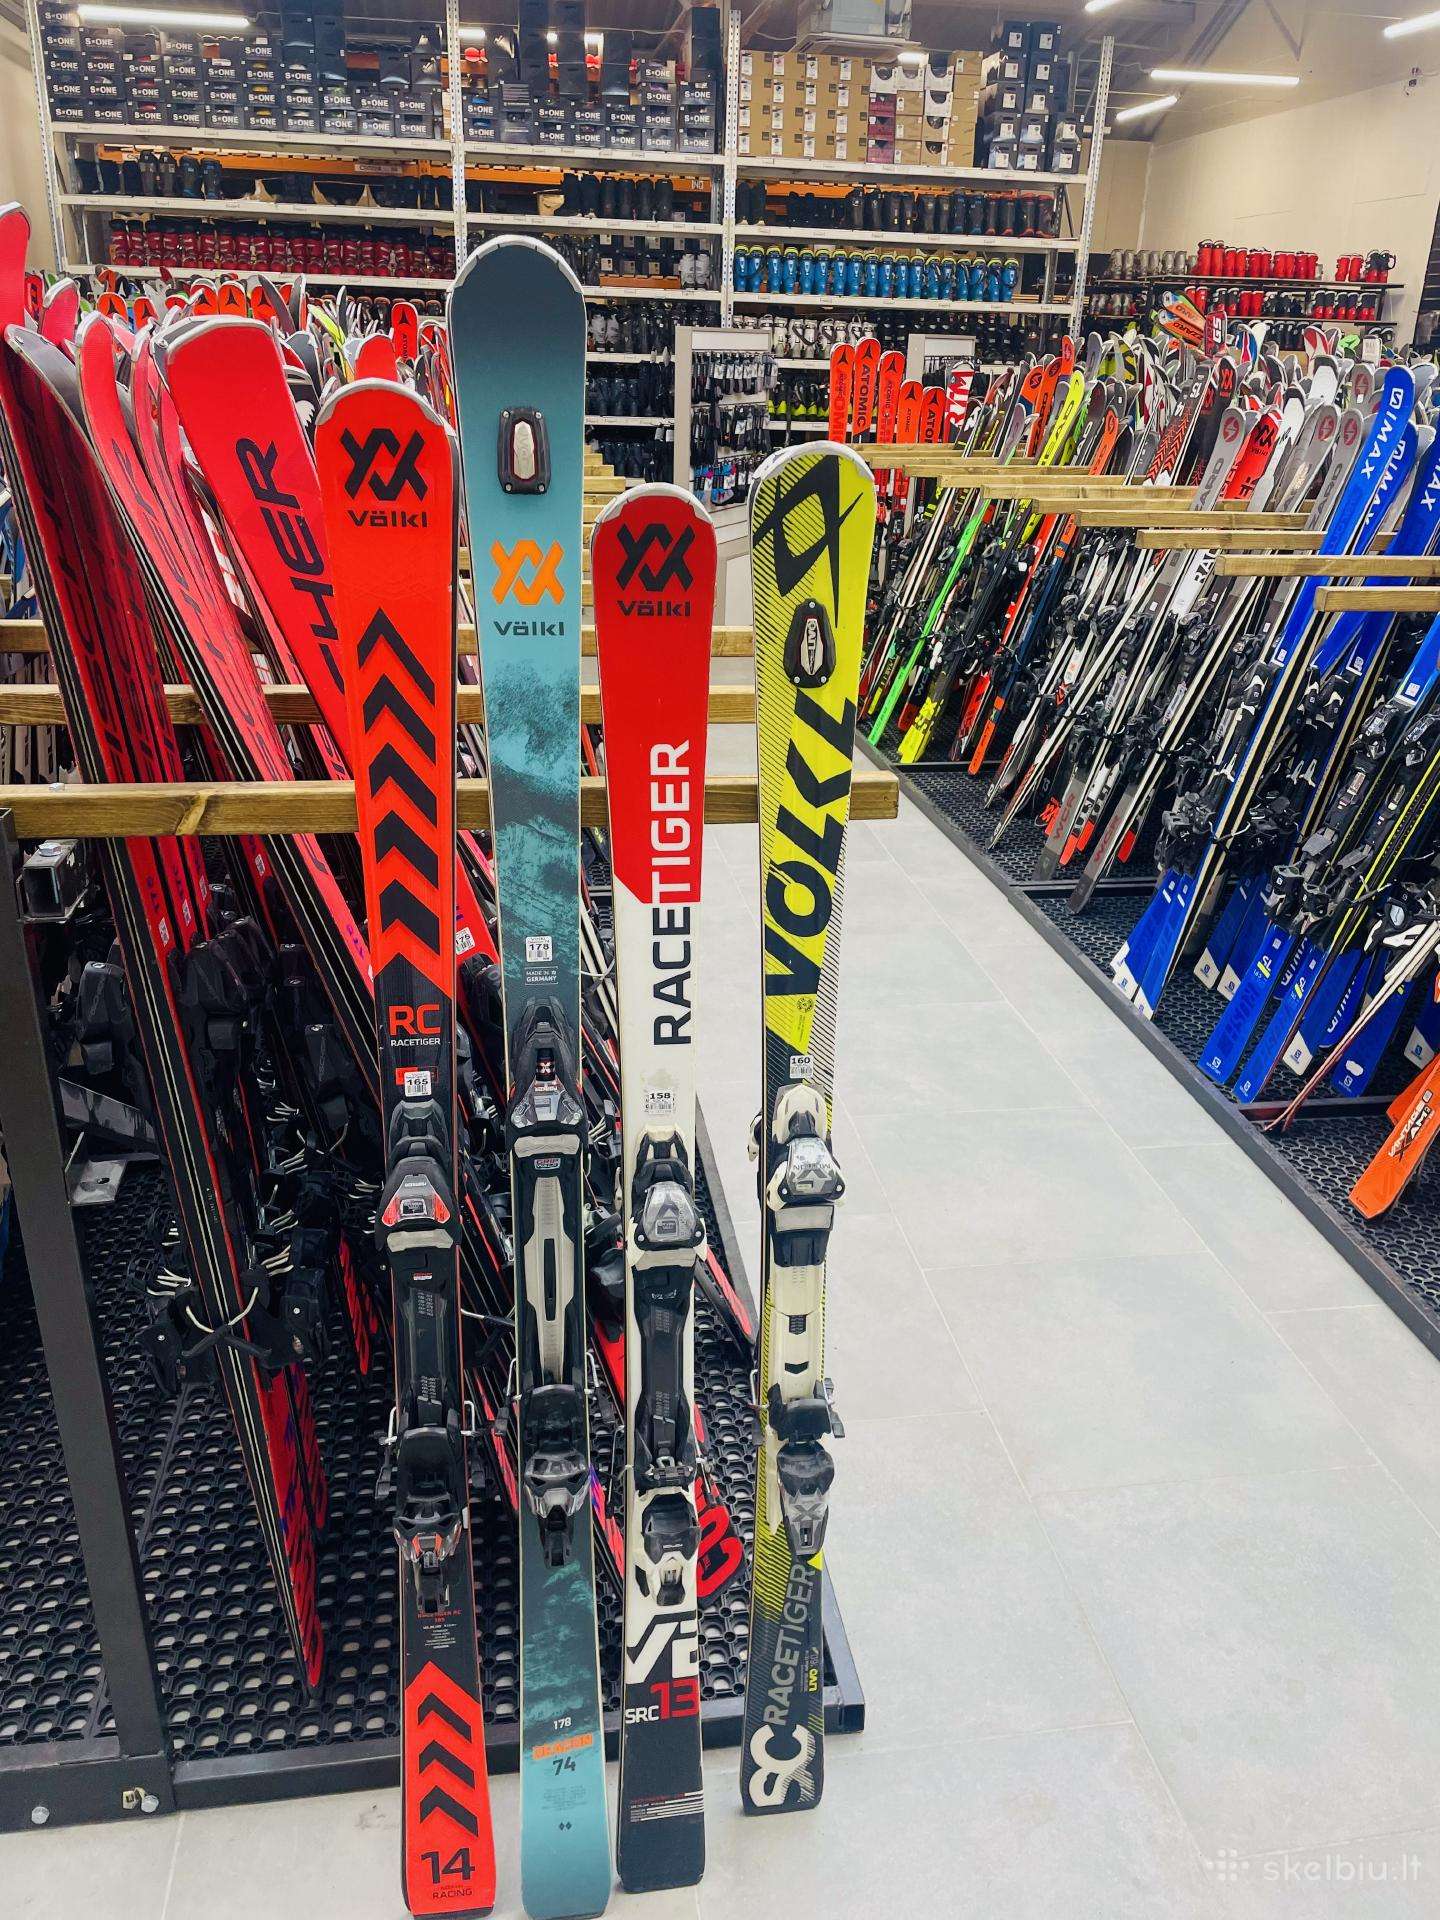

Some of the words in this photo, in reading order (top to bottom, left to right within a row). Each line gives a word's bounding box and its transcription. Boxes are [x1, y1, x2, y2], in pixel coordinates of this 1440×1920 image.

[857, 364, 872, 428] ATOMIC
[649, 739, 692, 1046] RACETIGER
[529, 942, 550, 951] 178
[388, 1003, 442, 1036] RC
[390, 1037, 441, 1047] RACETIGER
[791, 1055, 811, 1065] 160
[649, 1091, 671, 1100] 158
[763, 1563, 817, 1728] RACETIGER
[624, 1705, 660, 1724] SRC
[651, 1678, 700, 1720] 13
[553, 1716, 573, 1731] 178
[552, 1755, 577, 1777] 74
[420, 1847, 476, 1885] 14
